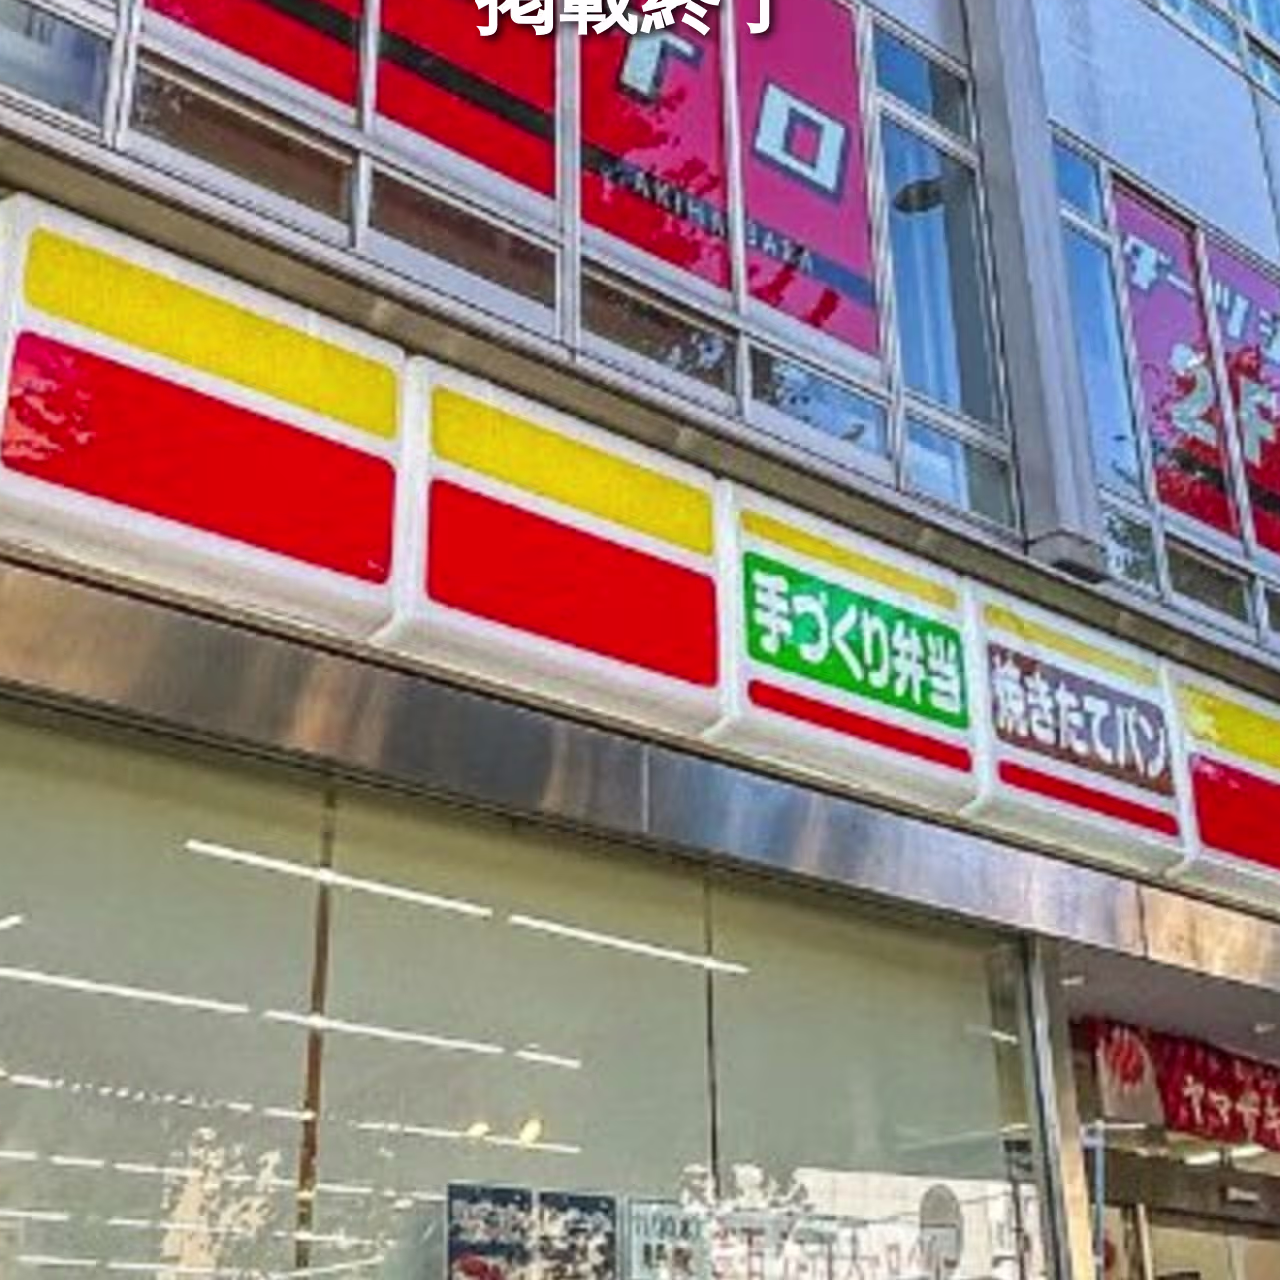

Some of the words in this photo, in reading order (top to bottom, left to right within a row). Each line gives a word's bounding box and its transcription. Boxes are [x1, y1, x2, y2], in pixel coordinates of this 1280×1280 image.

[1172, 364, 1280, 468] 2F
[753, 569, 962, 714] 手づくり弁当
[992, 655, 1168, 777] 焼きたてパン
